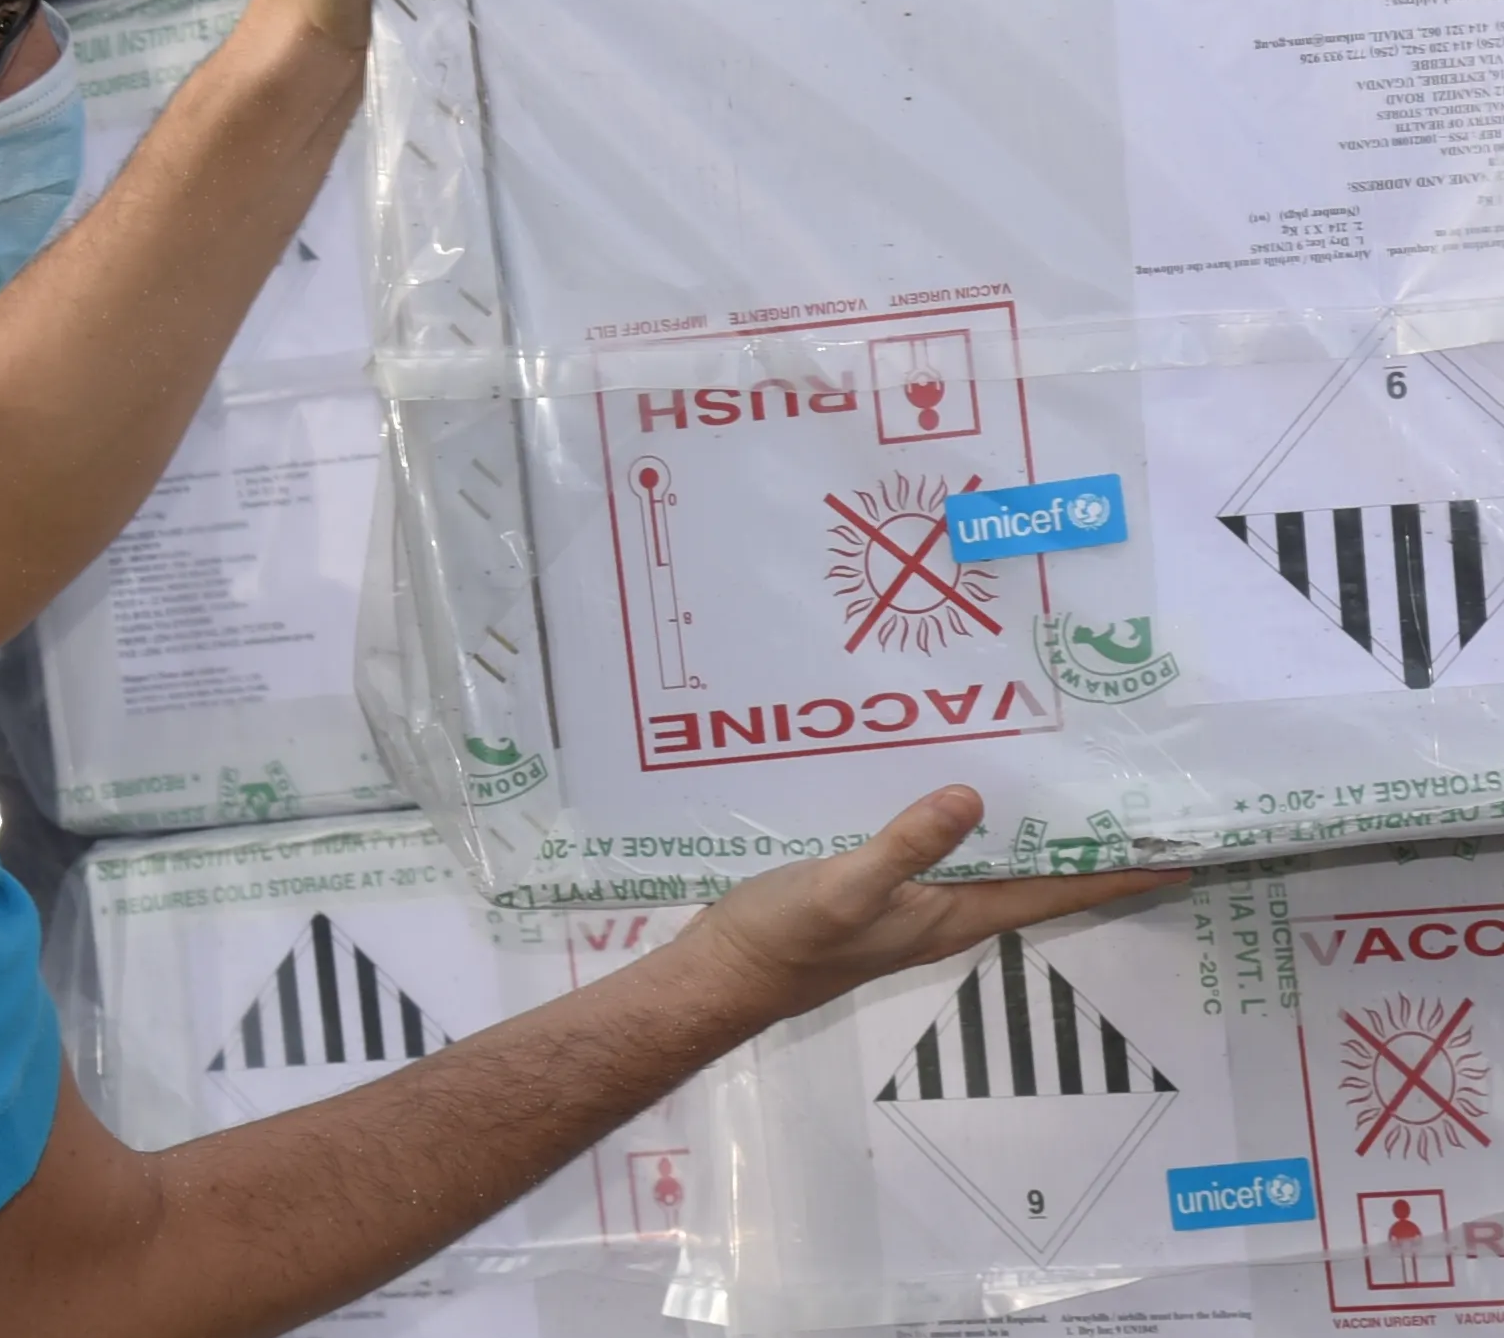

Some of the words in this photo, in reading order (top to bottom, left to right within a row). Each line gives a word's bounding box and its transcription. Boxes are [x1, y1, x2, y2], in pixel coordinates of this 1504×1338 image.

[890, 288, 951, 309] URGENT
[956, 282, 1012, 302] VACCIN
[805, 297, 868, 317] VACUNA
[956, 499, 1064, 547] unicef
[652, 677, 1051, 758] VACCINE
[1026, 1189, 1047, 1218] 9
[1177, 1180, 1265, 1220] unicef
[1333, 1317, 1381, 1329] VACCIN
[1385, 1315, 1436, 1327] URGENT
